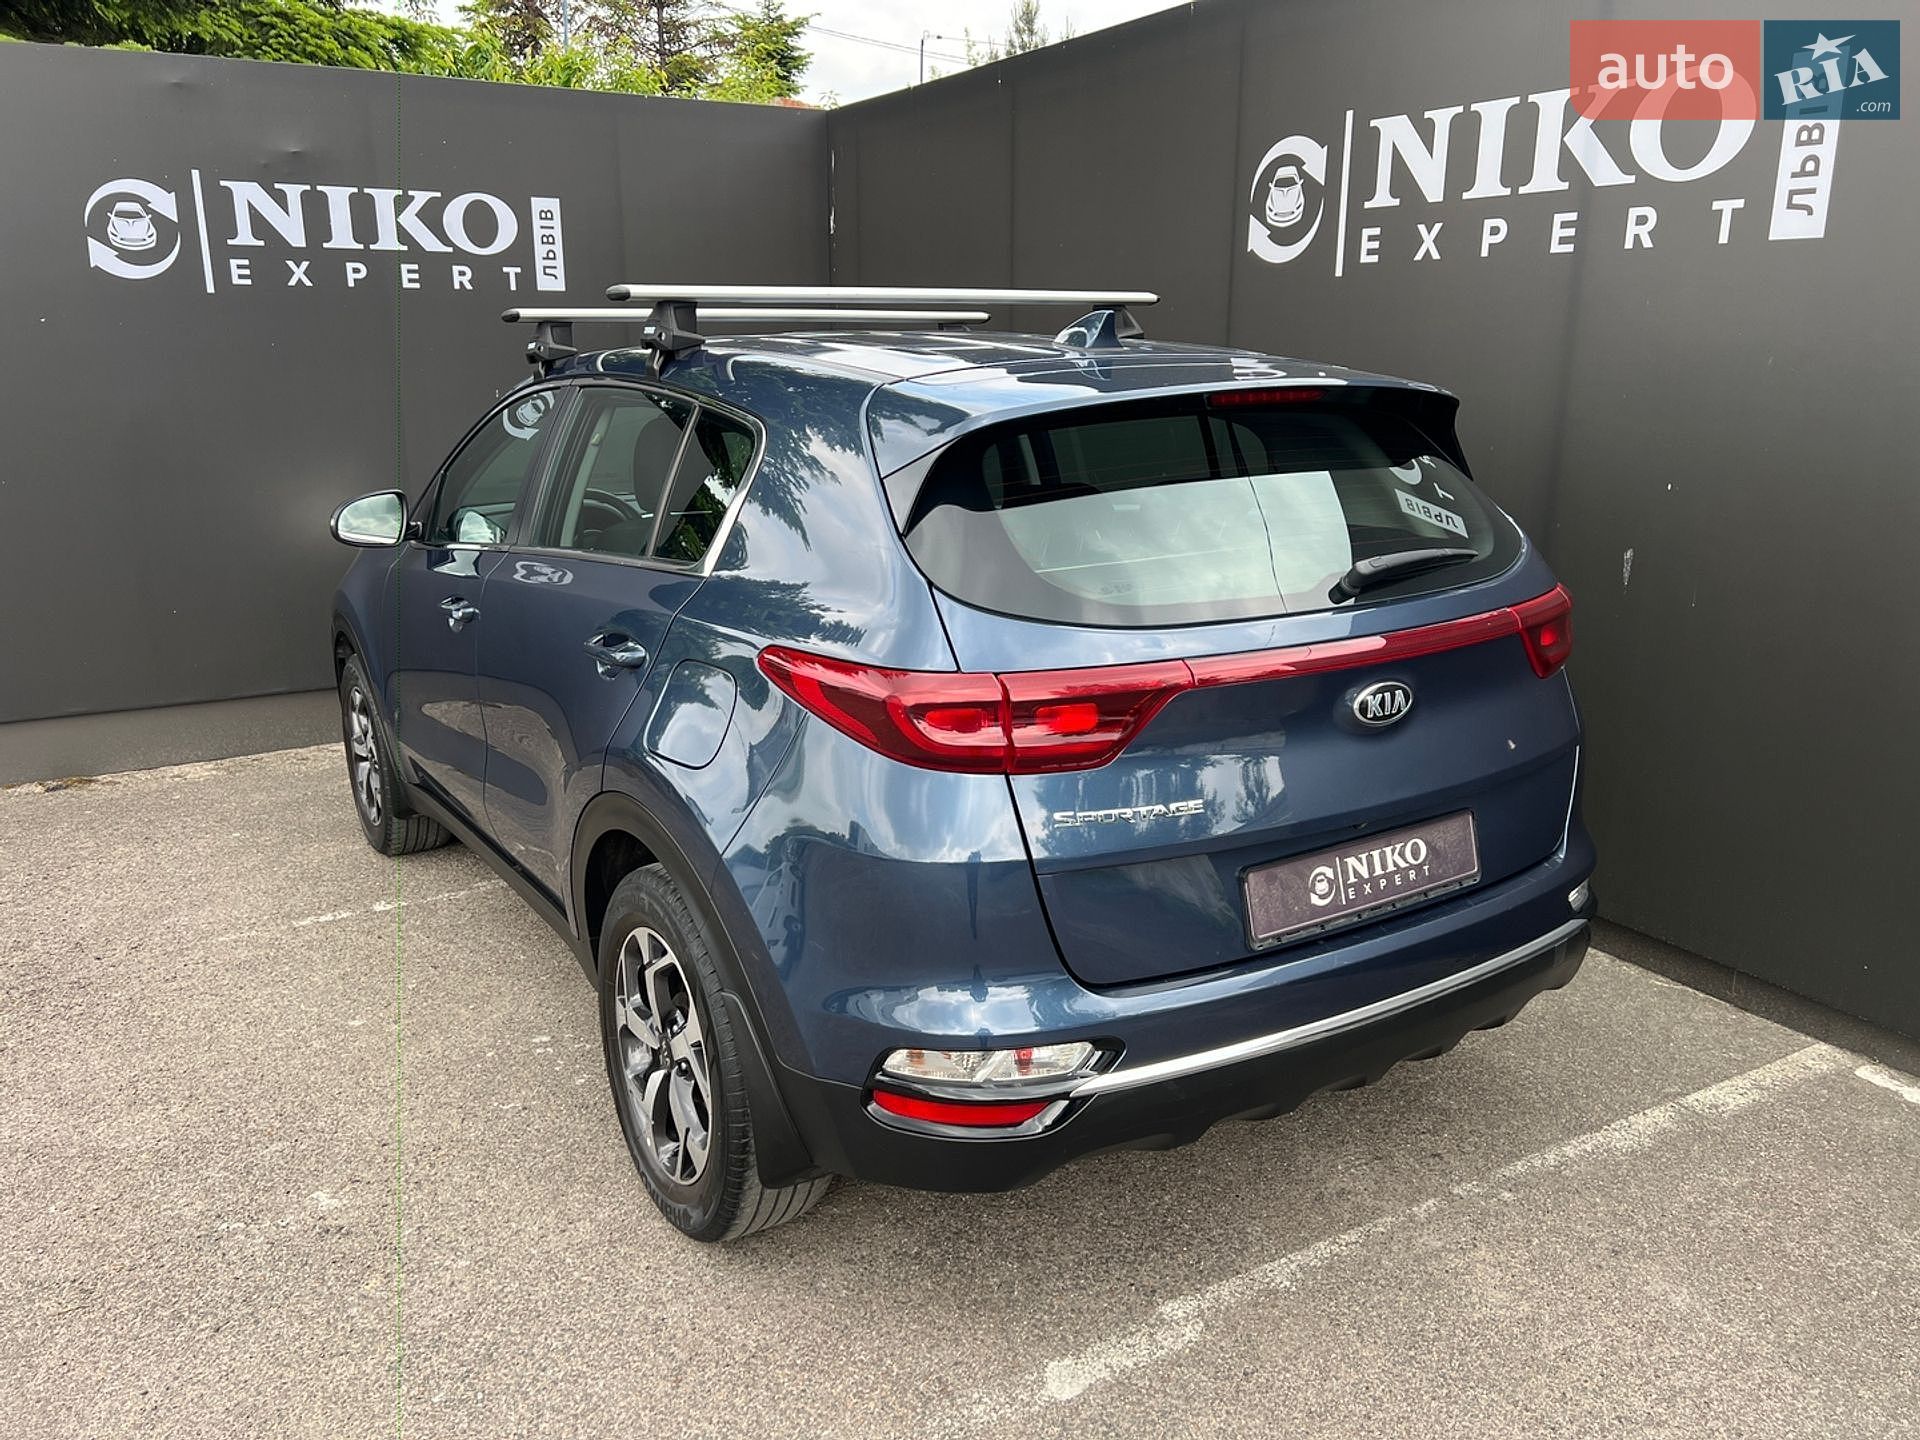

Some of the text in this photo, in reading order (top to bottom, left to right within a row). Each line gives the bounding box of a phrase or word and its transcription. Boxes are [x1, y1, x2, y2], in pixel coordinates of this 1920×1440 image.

[1363, 64, 1758, 210] NIKO
[219, 179, 519, 256] NIKO
[1359, 199, 1745, 264] EXPERT
[538, 207, 559, 280] ЛЬВІВ
[228, 257, 522, 291] EXPERT
[1366, 689, 1407, 719] KIA
[1053, 799, 1205, 829] SPORTAGE
[1344, 838, 1427, 884] NIKO
[1348, 865, 1430, 899] EXPERT
